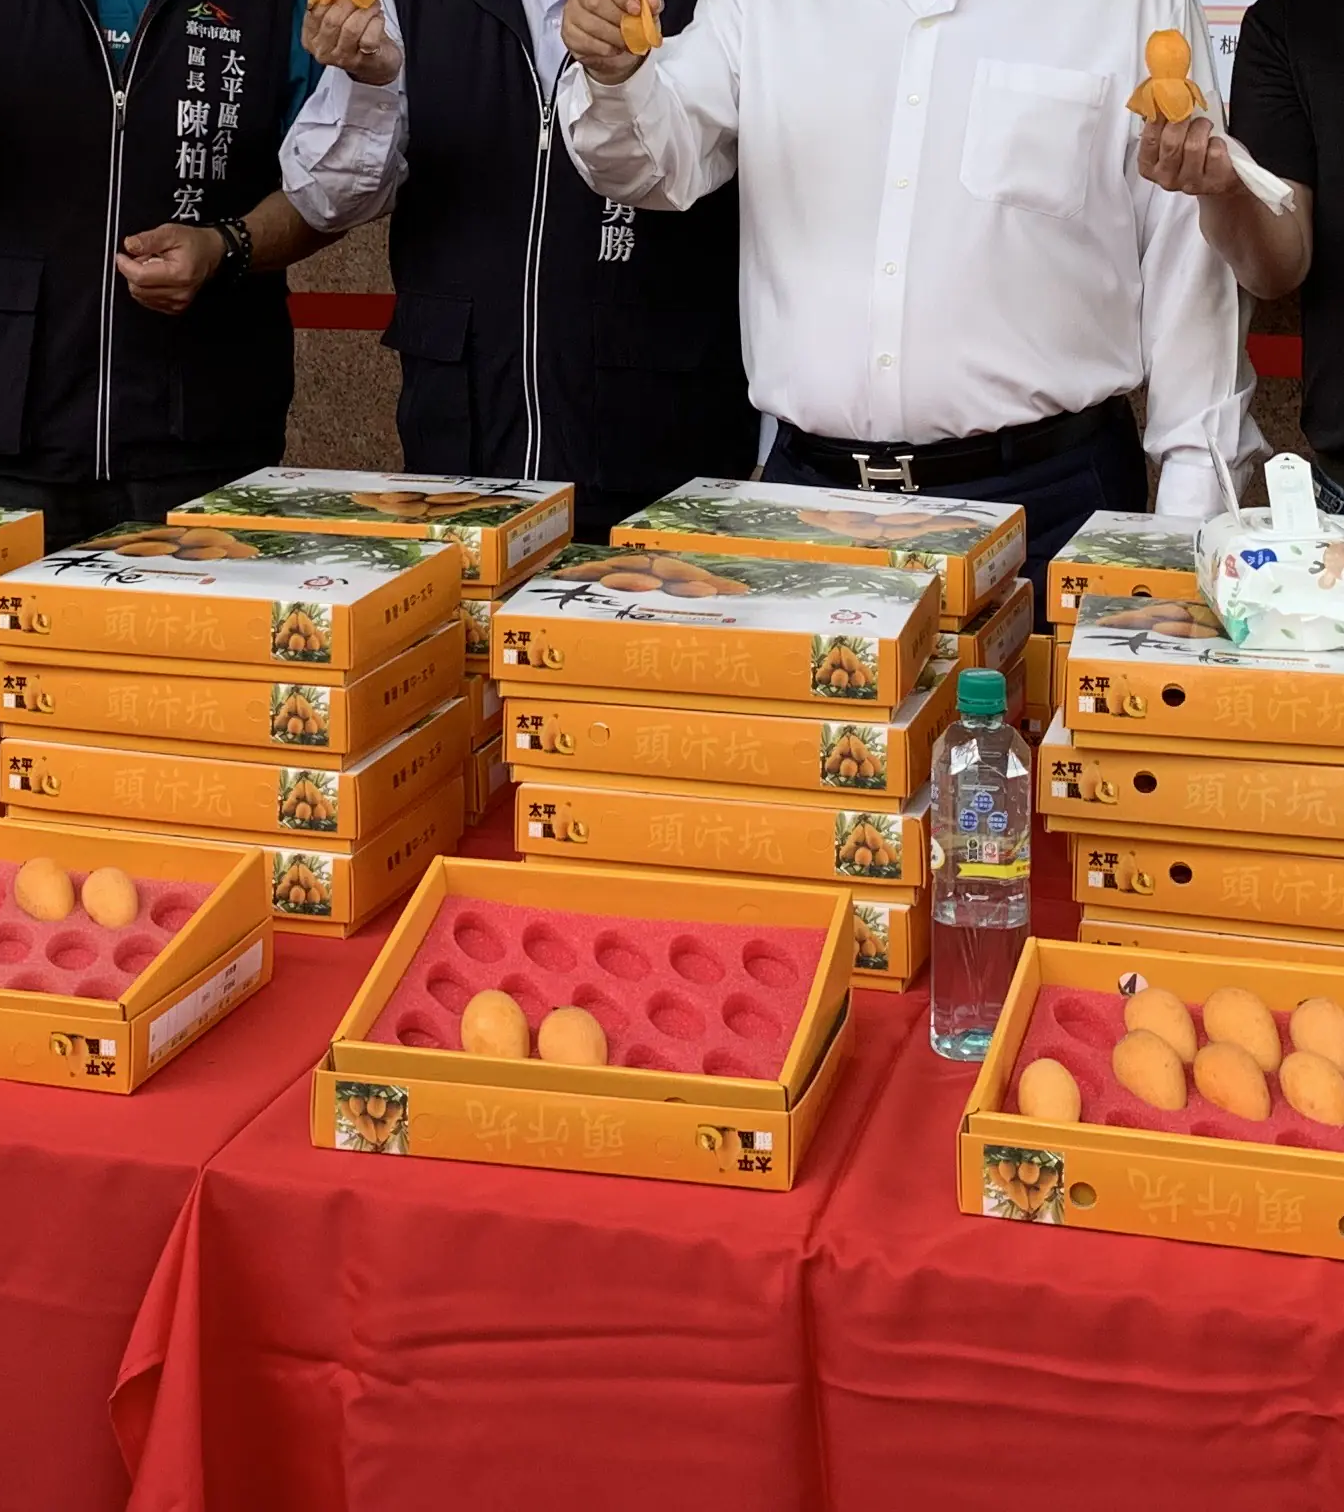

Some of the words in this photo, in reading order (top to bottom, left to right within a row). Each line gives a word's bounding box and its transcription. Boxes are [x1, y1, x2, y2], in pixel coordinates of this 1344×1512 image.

[186, 20, 242, 43] 臺中市政府
[212, 49, 246, 180] 太平區公所
[171, 99, 211, 222] 陳柏宏
[1061, 576, 1088, 591] 太平
[503, 630, 531, 646] 太平
[3, 676, 27, 691] 太平
[1079, 676, 1110, 693] 太平
[516, 714, 544, 730] 太平
[9, 756, 33, 772] 太平
[1052, 761, 1082, 778] 太平
[528, 803, 556, 819] 太平
[1088, 851, 1119, 868] 太平
[86, 1060, 116, 1078] 太平
[737, 1154, 772, 1173] 太平
